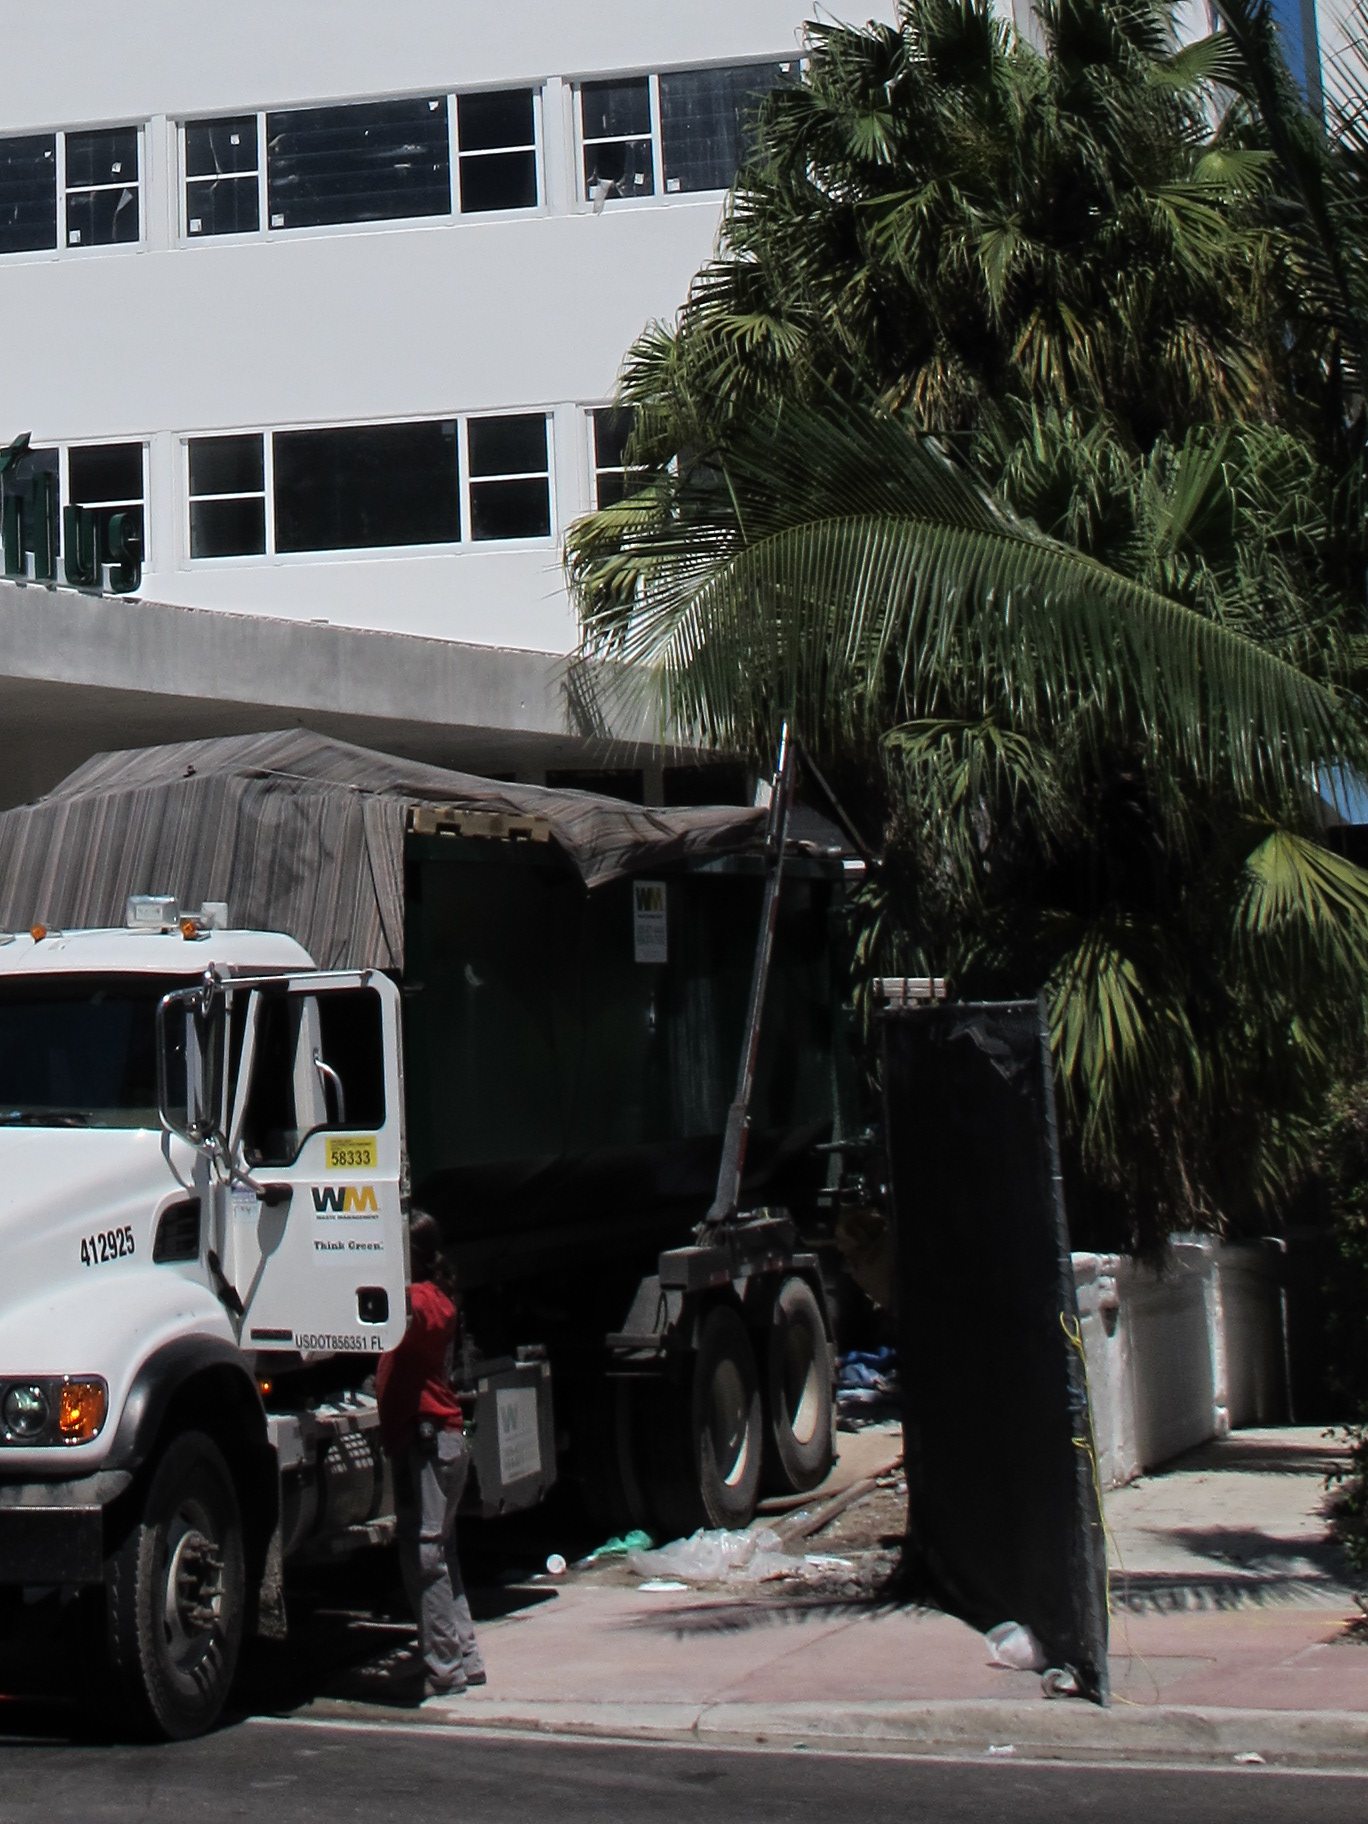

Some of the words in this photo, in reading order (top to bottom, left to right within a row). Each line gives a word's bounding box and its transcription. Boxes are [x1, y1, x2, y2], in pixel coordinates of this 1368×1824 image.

[331, 1149, 371, 1166] 58333
[311, 1186, 379, 1212] WM
[80, 1224, 135, 1267] 412925
[314, 1240, 345, 1251] Think
[295, 1333, 368, 1350] USDOT856351
[371, 1335, 384, 1350] FL
